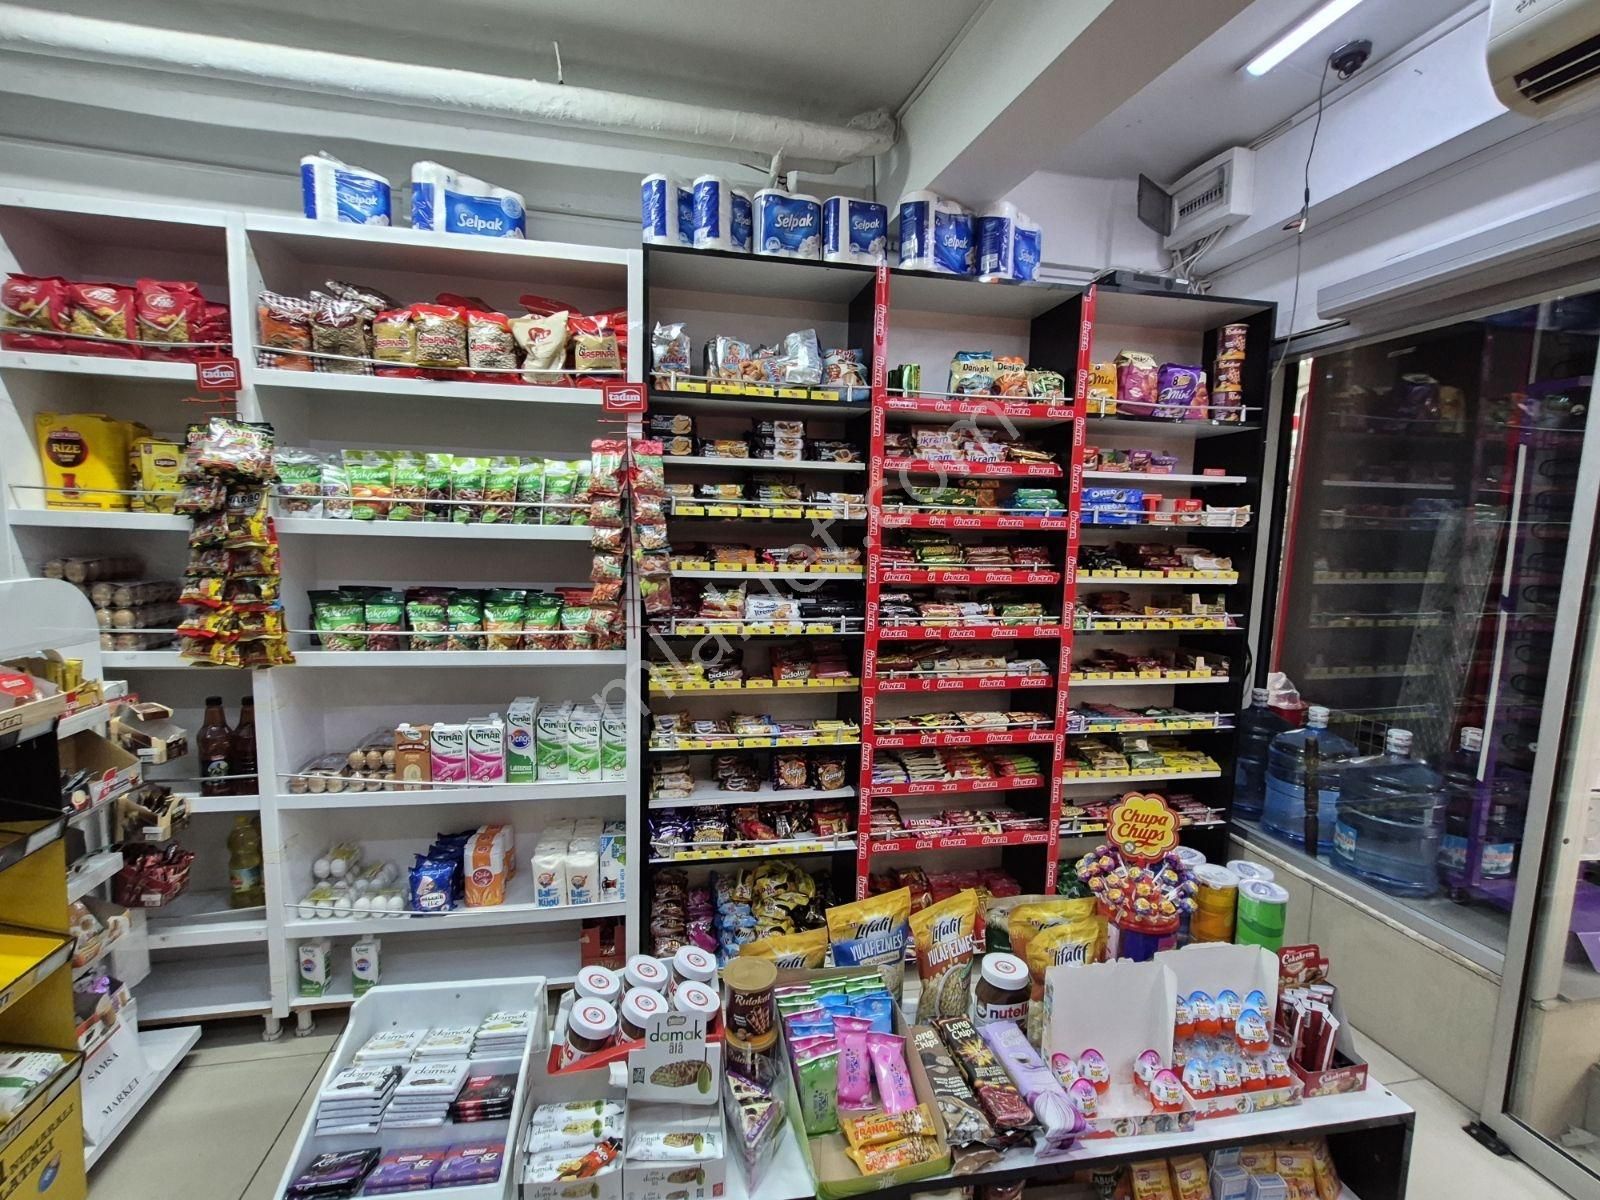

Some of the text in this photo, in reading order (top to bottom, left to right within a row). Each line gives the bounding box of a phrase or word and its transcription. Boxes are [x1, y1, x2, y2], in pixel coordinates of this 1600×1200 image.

[681, 211, 693, 221] Sel
[735, 214, 752, 226] Selpa
[457, 213, 502, 231] Selpak
[775, 214, 813, 230] Selpak
[853, 219, 880, 232] Selpak
[943, 234, 968, 249] Selpak
[963, 363, 990, 373] Dankek
[935, 401, 951, 411] ÜLK
[1048, 407, 1073, 418] ÜLKER
[52, 442, 81, 454] RİZE
[884, 459, 911, 469] ÜLKER
[986, 464, 1012, 473] ÜLKER
[1029, 466, 1054, 475] ÜLKER
[929, 516, 945, 525] ÜLK
[954, 516, 980, 526] ÜLKER
[998, 517, 1024, 527] ÜLKER
[1040, 518, 1066, 528] ÜLKER
[884, 572, 911, 581] ÜLKER
[943, 573, 969, 582] ÜLKER
[986, 573, 1012, 582] ÜLKER
[1028, 573, 1053, 582] ÜLKER
[880, 628, 907, 638] ÜLKER
[925, 628, 941, 637] ÜLK
[949, 629, 975, 638] ÜLKER
[992, 628, 1017, 637] ÜLKER
[1034, 627, 1059, 636] ÜLKER
[708, 670, 734, 679] bidolu
[781, 671, 805, 680] bidolu
[879, 681, 906, 690] ÜLKER
[938, 679, 963, 688] ÜLKER
[979, 678, 1005, 687] ÜLKER
[1021, 677, 1046, 686] ÜLKER
[877, 737, 903, 745] ÜLKER
[921, 735, 936, 744] ÜLK
[944, 734, 970, 743] ÜLKER
[987, 733, 1012, 742] ÜLKER
[1029, 732, 1053, 741] ÜLKER
[824, 772, 842, 781] Gong
[973, 780, 998, 788] ÜLKER
[1013, 778, 1037, 786] ÜLKER
[909, 783, 934, 792] ÜLKER
[1121, 808, 1169, 827] Chupa
[1023, 834, 1048, 842] ÜLKER
[1117, 824, 1166, 846] Chups
[917, 839, 932, 849] ÜLK
[941, 838, 966, 847] ÜLKER
[983, 836, 1007, 844] ÜLKER
[873, 842, 899, 851] ÜLKER
[855, 917, 894, 940] Lifalif
[932, 915, 964, 944] Lifalif
[950, 934, 975, 959] EZMES
[735, 992, 772, 1006] Rulokat
[989, 1004, 1029, 1020] nutell
[946, 1019, 970, 1032] Long
[650, 1020, 702, 1042] damak
[952, 1028, 976, 1041] Chips
[87, 1051, 120, 1082] SAMSA
[414, 1064, 458, 1075] damak
[102, 1077, 140, 1117] MARKET
